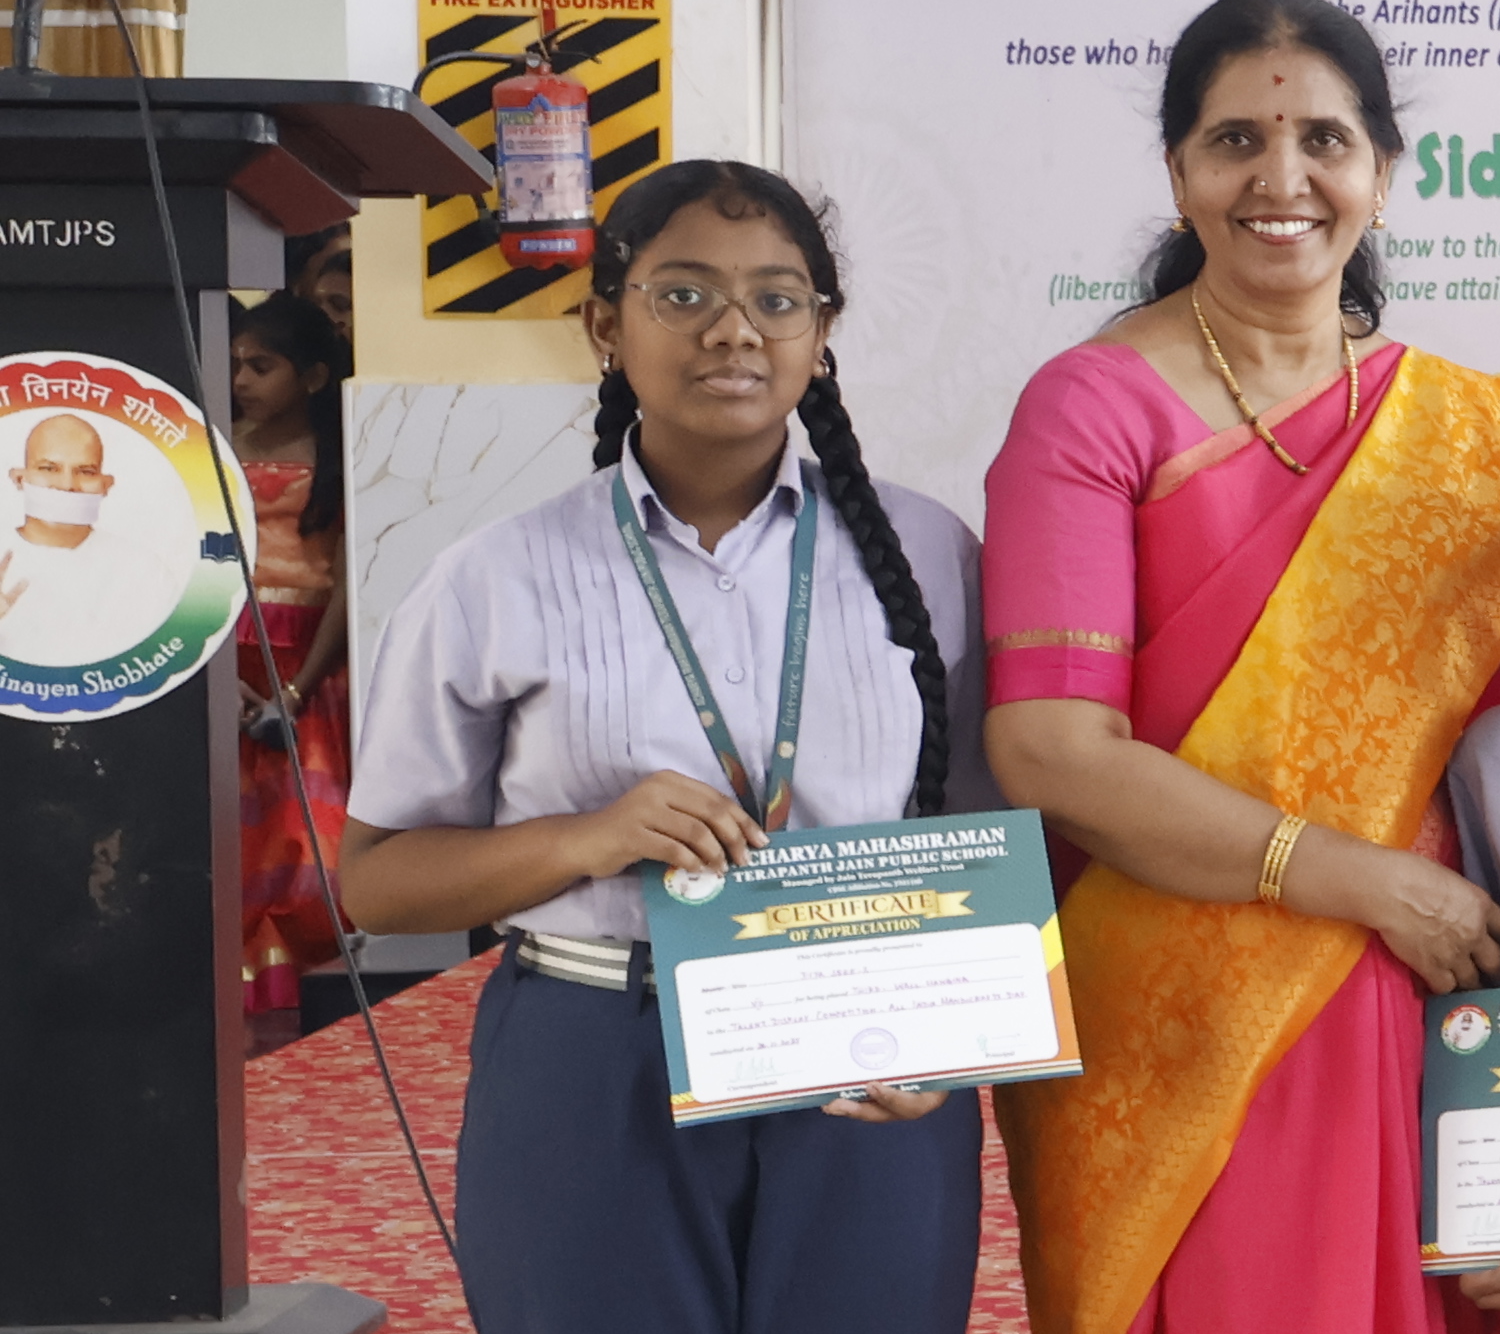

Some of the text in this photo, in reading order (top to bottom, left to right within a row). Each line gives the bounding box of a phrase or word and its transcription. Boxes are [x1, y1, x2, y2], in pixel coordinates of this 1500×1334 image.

[1373, 0, 1480, 26] Arihants
[1006, 39, 1075, 65] those
[1085, 41, 1137, 65] who
[1425, 45, 1489, 69] inner
[1385, 232, 1433, 260] bow
[1444, 233, 1468, 260] to
[21, 372, 113, 407] विनयेन
[121, 394, 188, 448] शोभते
[794, 572, 809, 611] here
[82, 635, 185, 695] Shobhate
[732, 827, 1006, 869] CHARYA MAHASHRAMAN
[772, 891, 934, 925] CERTIFICATE
